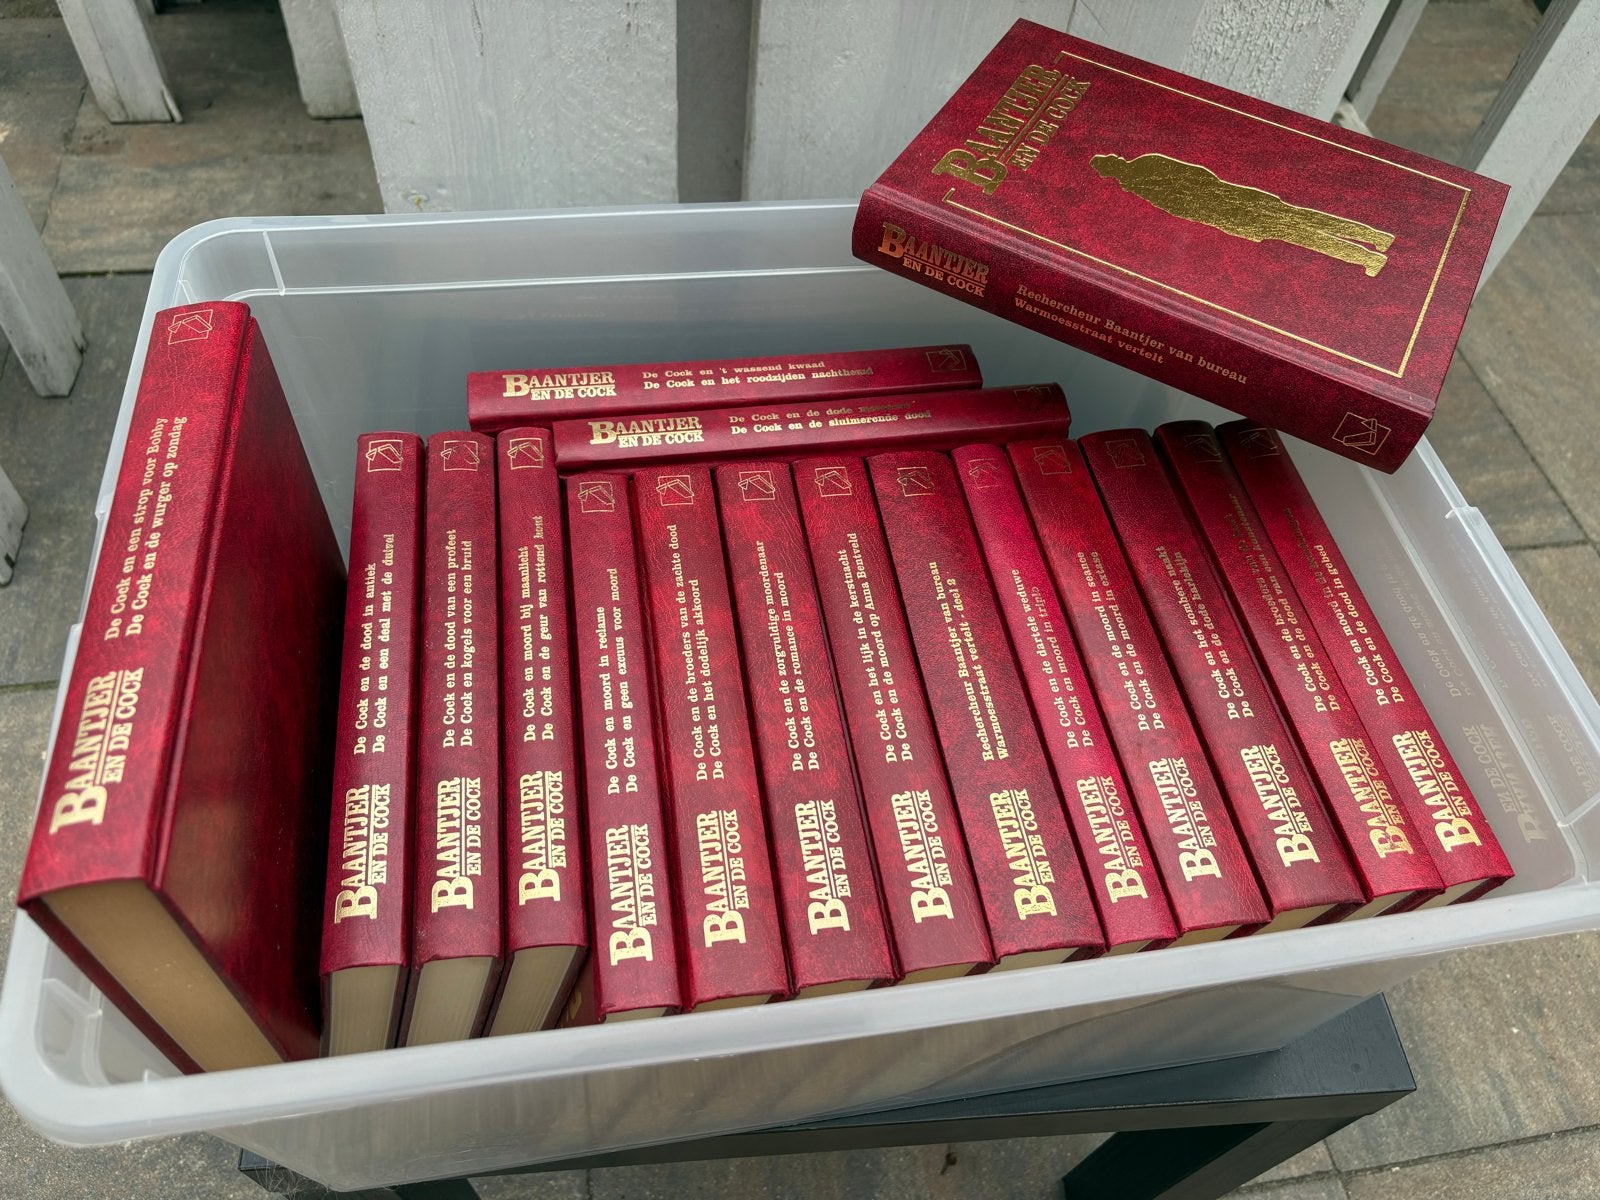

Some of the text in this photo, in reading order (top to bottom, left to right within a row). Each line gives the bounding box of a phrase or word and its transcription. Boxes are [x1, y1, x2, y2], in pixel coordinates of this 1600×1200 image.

[931, 64, 1062, 195] BAANTJER
[1006, 76, 1091, 171] EN DE COCK
[878, 221, 988, 284] BAANTJER
[502, 372, 615, 397] BAANTJER
[664, 369, 693, 377] Cock
[733, 363, 782, 373] wassend
[788, 360, 825, 369] kwaad
[1014, 296, 1163, 363] Warmoesstraat vertelt
[1016, 283, 1246, 384] Rechercheur Baantjer van bureau
[588, 416, 702, 444] BAANTJER
[618, 430, 704, 448] EN DE COCK
[730, 425, 747, 434] De
[752, 422, 782, 432] Cock
[787, 422, 803, 430] en
[808, 419, 822, 428] de
[103, 417, 168, 640] De Cock en een strop voor Bobby
[353, 562, 376, 755] De Cock en de dood in antiek
[459, 540, 475, 746] De Cock en kogels voor een bruid
[517, 545, 535, 742] De Cock en moord bij maanlicht
[666, 524, 707, 781] De Cock en de broeders van de zachte dood
[755, 540, 803, 771] De Cock en de zorgvuldige moordenaar
[846, 532, 913, 761] De Cock en de moord op Anna Bentveld
[928, 561, 994, 761] Rechercheur Baantjer van bureau
[948, 588, 964, 611] deel
[958, 621, 979, 661] vertelt
[1011, 569, 1079, 748] De Cock en de dartele weduwe
[1076, 551, 1150, 731] De Cock en de moord in seance
[1172, 579, 1198, 625] sombere
[1192, 628, 1208, 648] het
[1204, 650, 1216, 665] en
[1313, 544, 1404, 703] De Cock en de dood in gebed
[101, 666, 144, 784] EN DE COCK
[595, 606, 620, 794] De Cock en moord in reclame
[971, 663, 1009, 760] Warmoesstraat
[1210, 668, 1230, 698] Cock
[1226, 702, 1240, 719] De
[50, 670, 117, 834] BAANTJER
[1242, 745, 1320, 868] BAANTJER
[1329, 738, 1413, 859] BAANTJER
[1351, 737, 1405, 825] EN DE COCK
[1392, 731, 1482, 853] BAANTJER
[335, 785, 377, 924] BAANTJER
[370, 783, 390, 885] EN DE COCK
[431, 777, 474, 913] BAANTJER
[518, 771, 560, 906] BAANTJER
[634, 823, 657, 926] EN DE COCK
[696, 811, 747, 948] BAANTJER
[796, 800, 850, 935] BAANTJER
[891, 791, 954, 924] BAANTJER
[915, 789, 953, 886] EN DE COCK
[990, 790, 1057, 921] BAANTJER
[1076, 776, 1148, 903] BAANTJER
[1149, 758, 1222, 882] BAANTJER
[606, 824, 652, 967] BAANTJER
